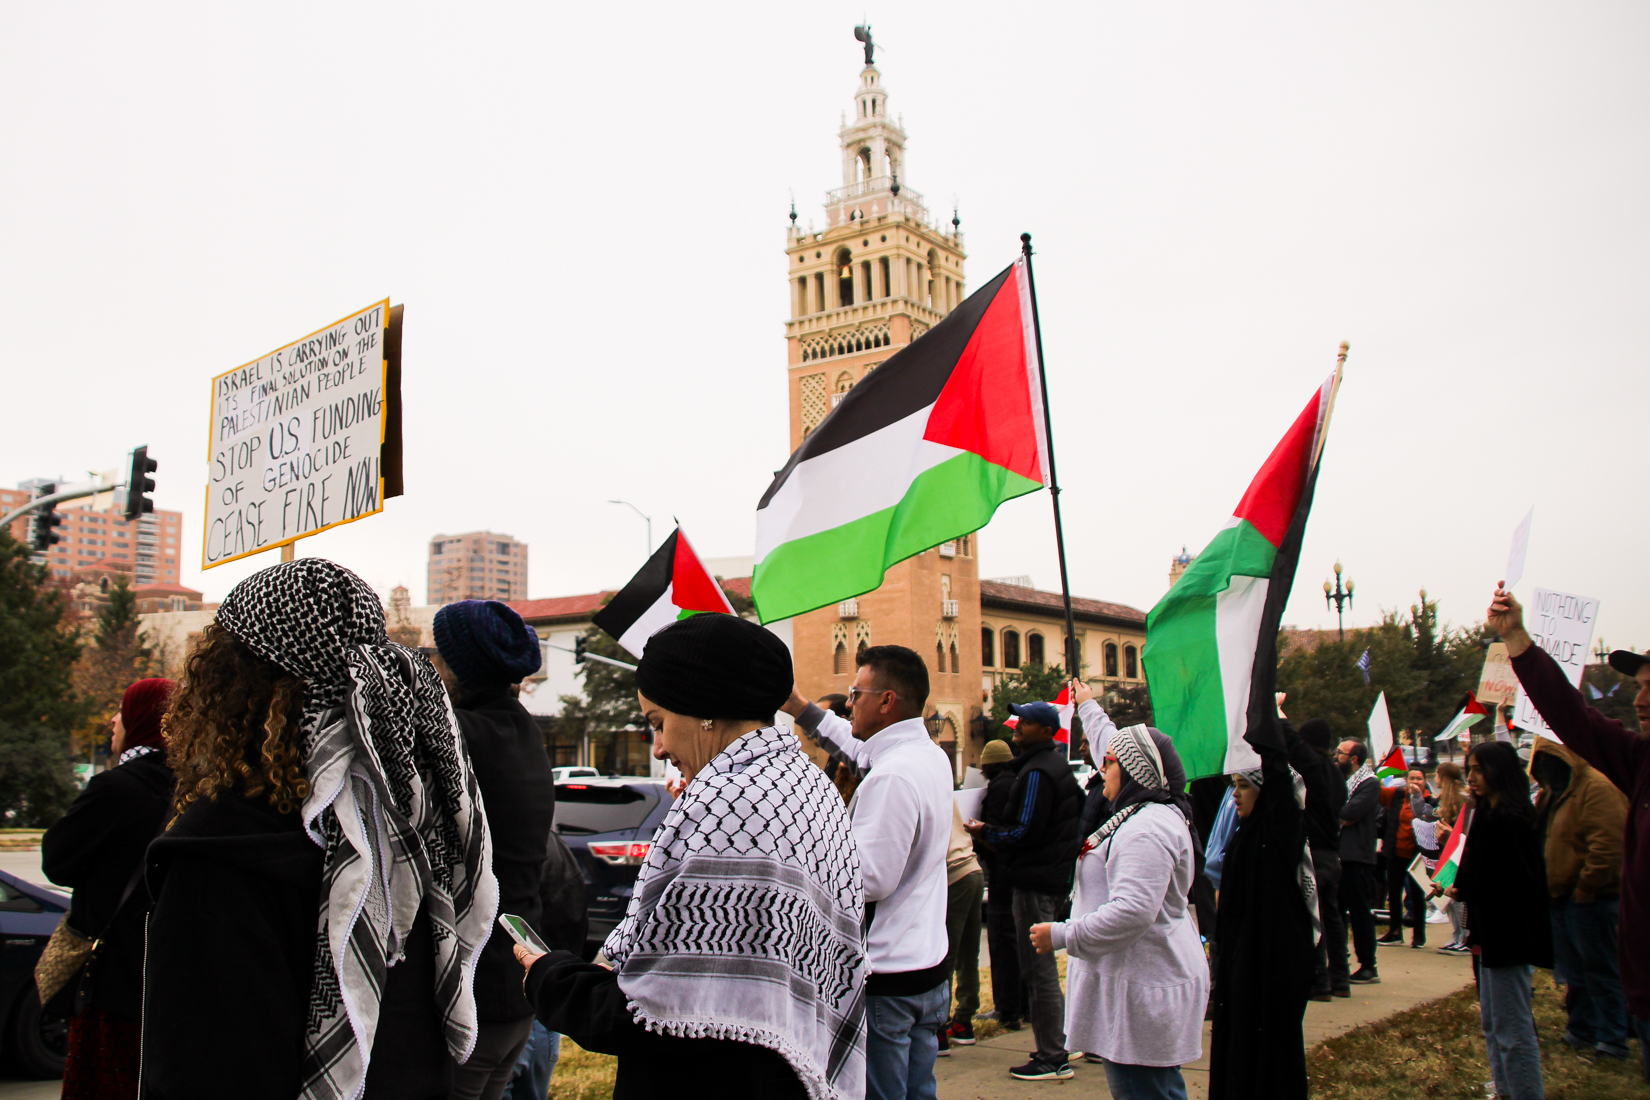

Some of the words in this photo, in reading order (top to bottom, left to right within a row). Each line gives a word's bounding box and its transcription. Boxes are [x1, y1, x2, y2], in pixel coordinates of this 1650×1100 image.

[218, 362, 263, 398] ISRAEL
[271, 352, 282, 373] IS
[288, 326, 347, 367] CARRYING
[354, 307, 382, 335] OUT
[218, 394, 238, 416] ITS
[250, 379, 277, 403] FINAL
[282, 355, 329, 387] SOLUTION
[333, 345, 349, 367] ON
[354, 332, 378, 355] THE
[212, 436, 261, 483] STOP
[269, 417, 301, 460] U.S.
[312, 387, 385, 443] FUNDING
[220, 380, 311, 441] PALESTINIAN
[318, 355, 366, 393] PEOPLE
[207, 500, 268, 561] CEASE
[282, 474, 332, 537] FIRE
[343, 457, 378, 520] NOW
[221, 481, 244, 506] OF
[262, 436, 351, 492] GENOCIDE
[1536, 591, 1592, 623] NOTHING
[1541, 614, 1556, 635] TO
